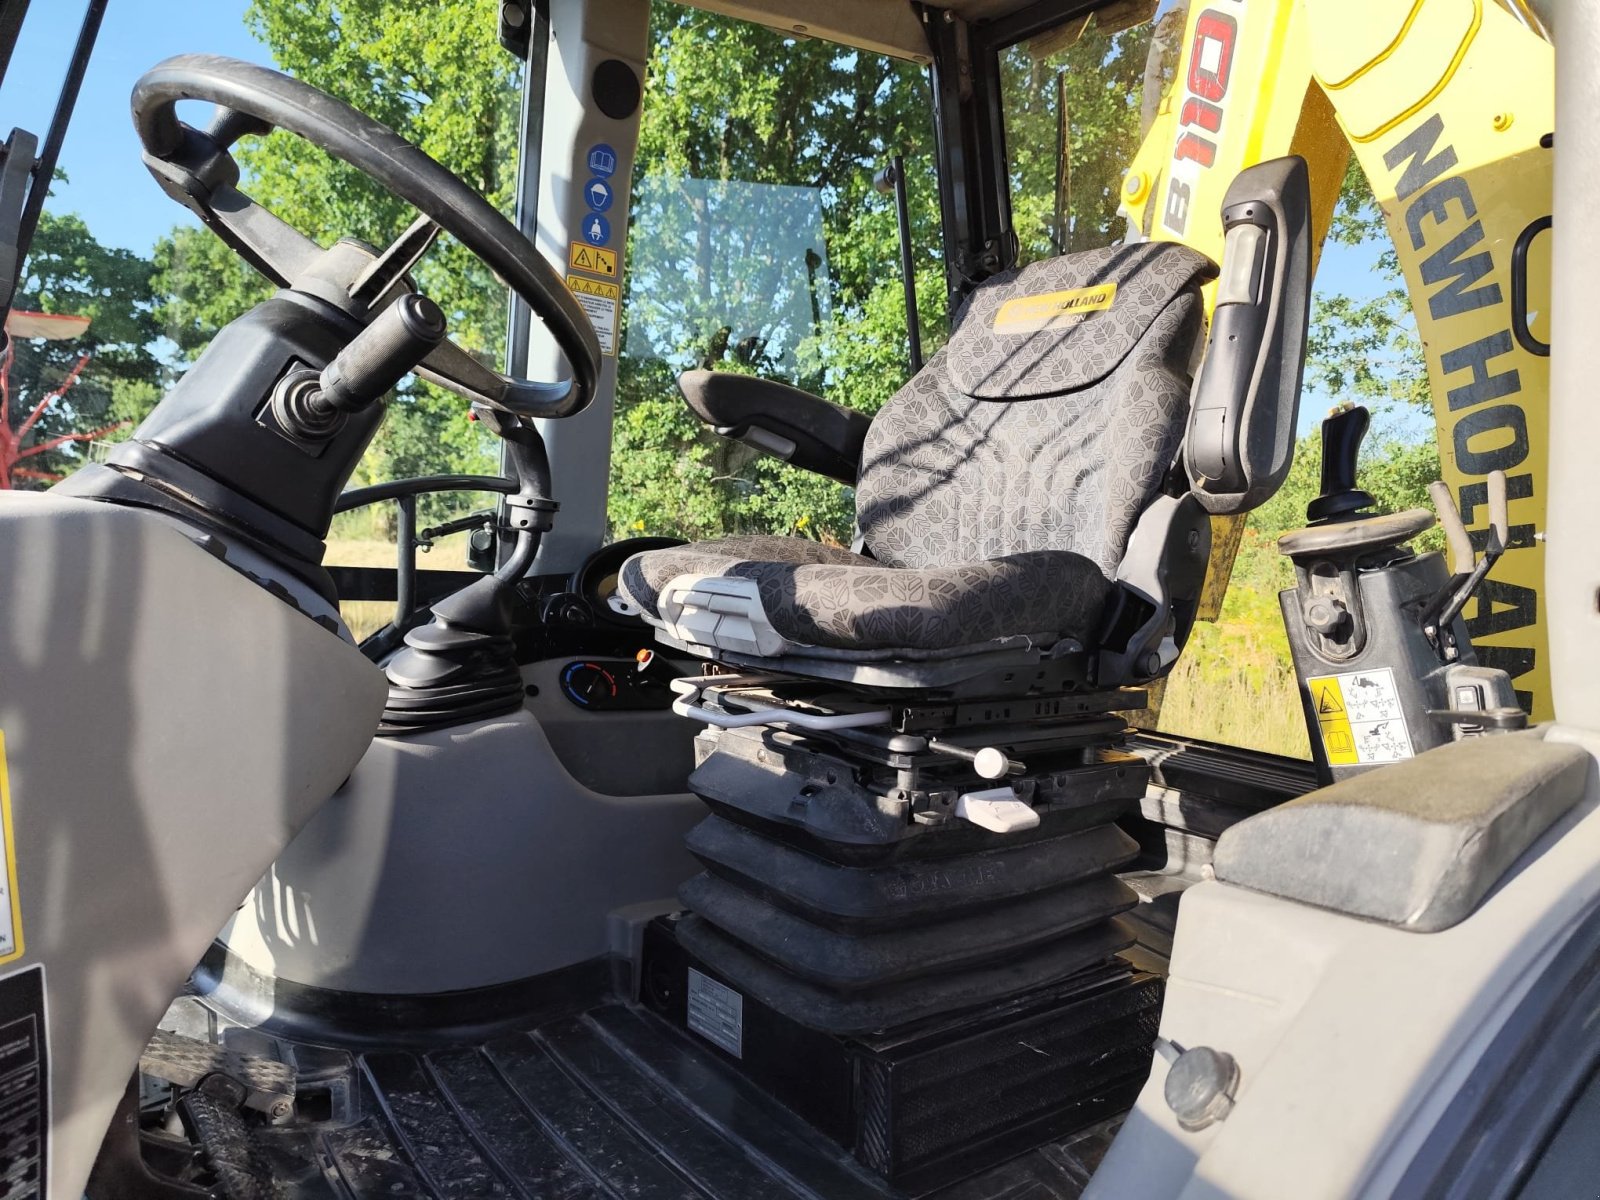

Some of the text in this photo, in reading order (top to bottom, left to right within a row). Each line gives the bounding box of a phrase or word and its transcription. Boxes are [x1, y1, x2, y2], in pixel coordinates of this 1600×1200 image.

[1163, 0, 1242, 238] B110
[1383, 113, 1503, 320] NEW
[1053, 293, 1107, 311] HOLLAND
